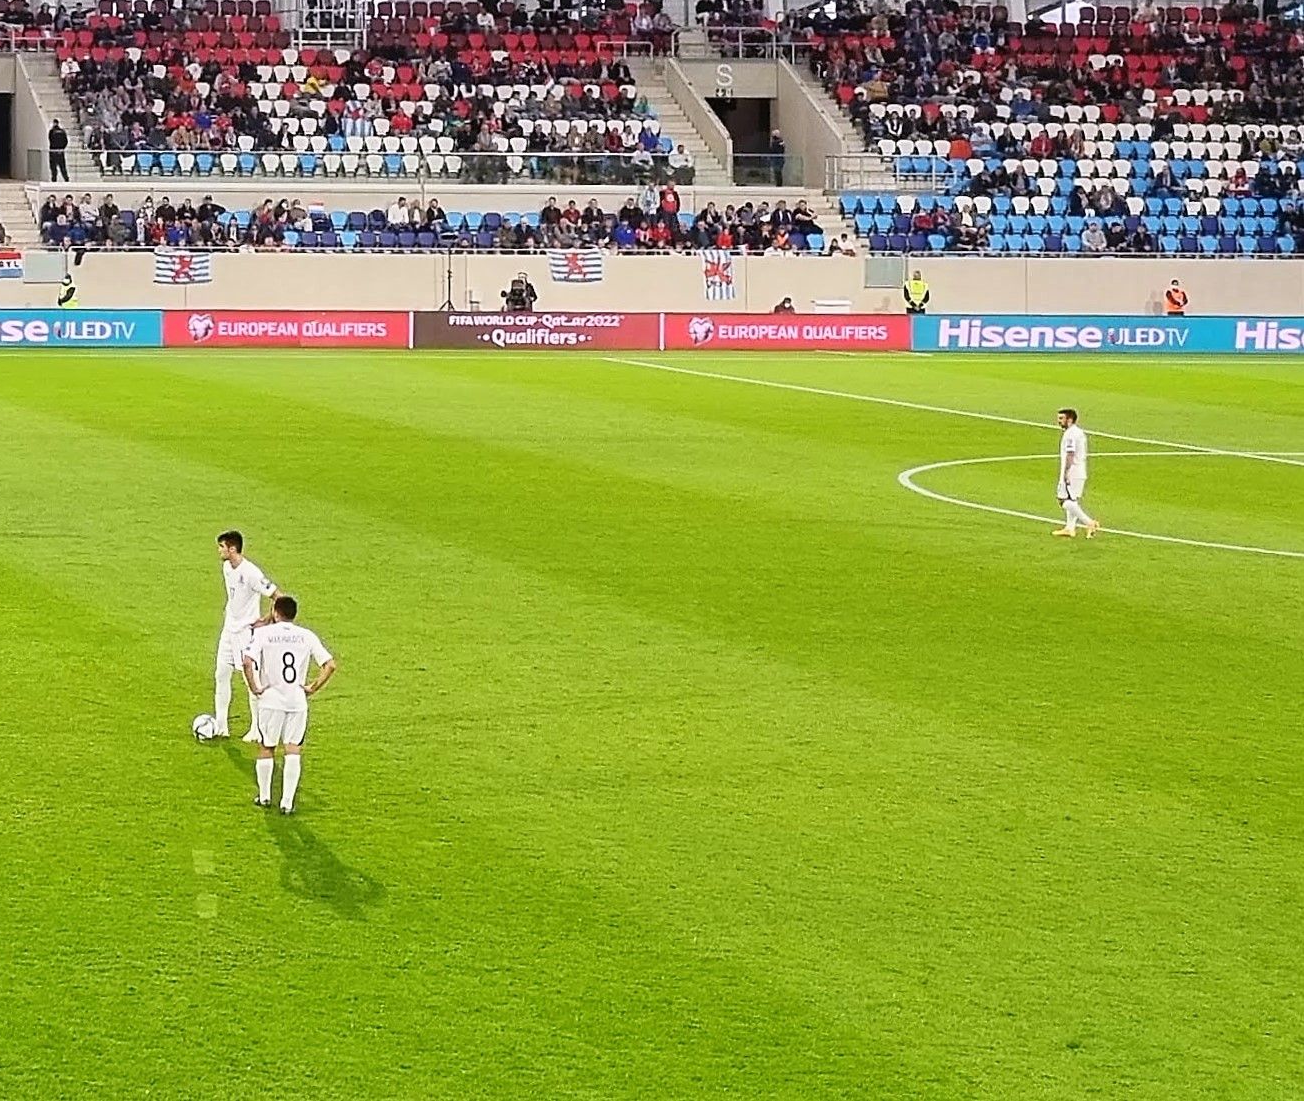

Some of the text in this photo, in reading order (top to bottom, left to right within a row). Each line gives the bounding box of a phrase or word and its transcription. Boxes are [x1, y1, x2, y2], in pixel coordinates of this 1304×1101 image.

[716, 63, 733, 87] S
[218, 321, 388, 338] EUROPEAN QUALIFIERS
[448, 315, 473, 326] FIFA
[473, 315, 515, 326] WORLD
[492, 329, 577, 347] Qualifiers
[718, 325, 888, 341] EUROPEAN QUALIFIERS
[938, 318, 1101, 348] Hisense
[1235, 321, 1304, 349] His
[282, 651, 297, 684] 8
